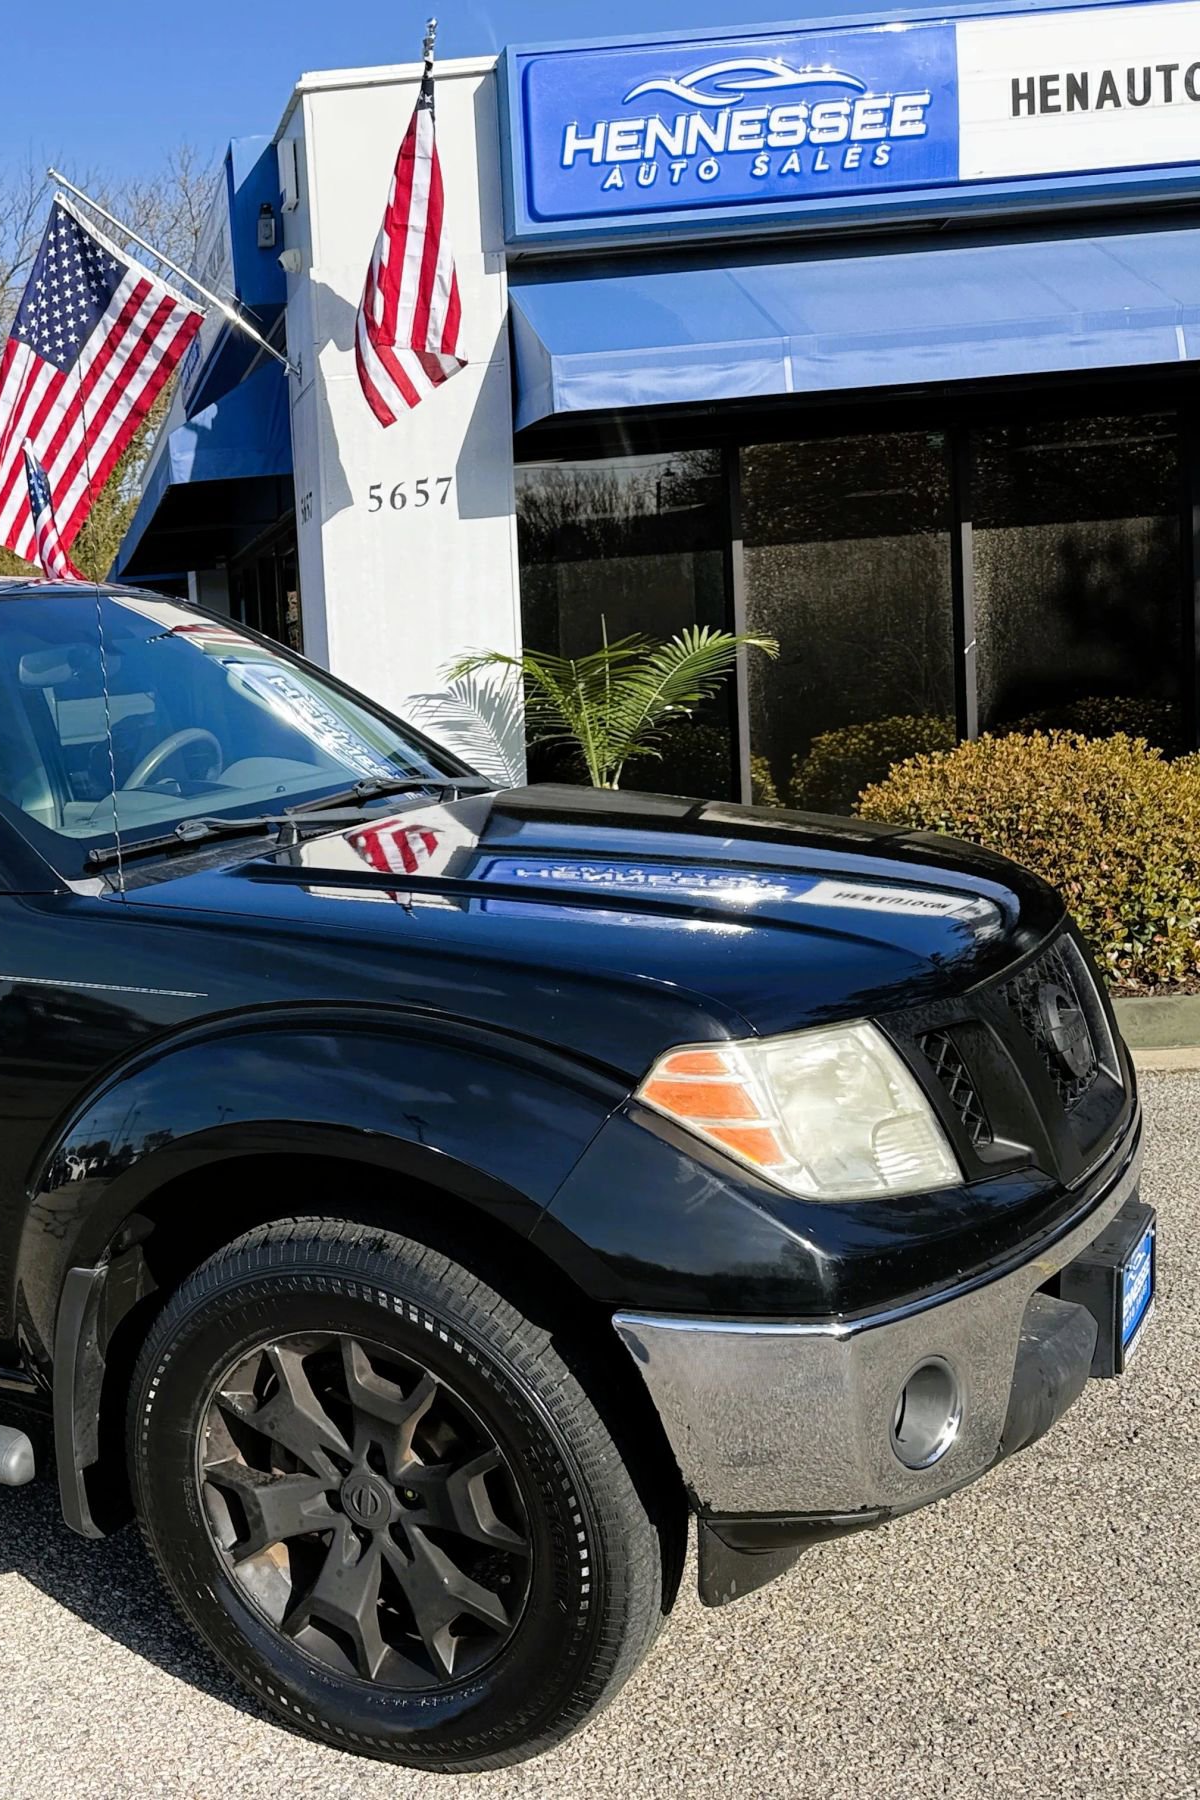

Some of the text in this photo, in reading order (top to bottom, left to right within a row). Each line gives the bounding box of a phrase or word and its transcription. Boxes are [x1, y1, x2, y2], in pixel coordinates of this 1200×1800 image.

[1011, 61, 1200, 117] HENAUTO
[562, 93, 931, 166] HENNESSEE
[603, 143, 892, 189] AUTO SALES
[367, 476, 453, 513] 5657
